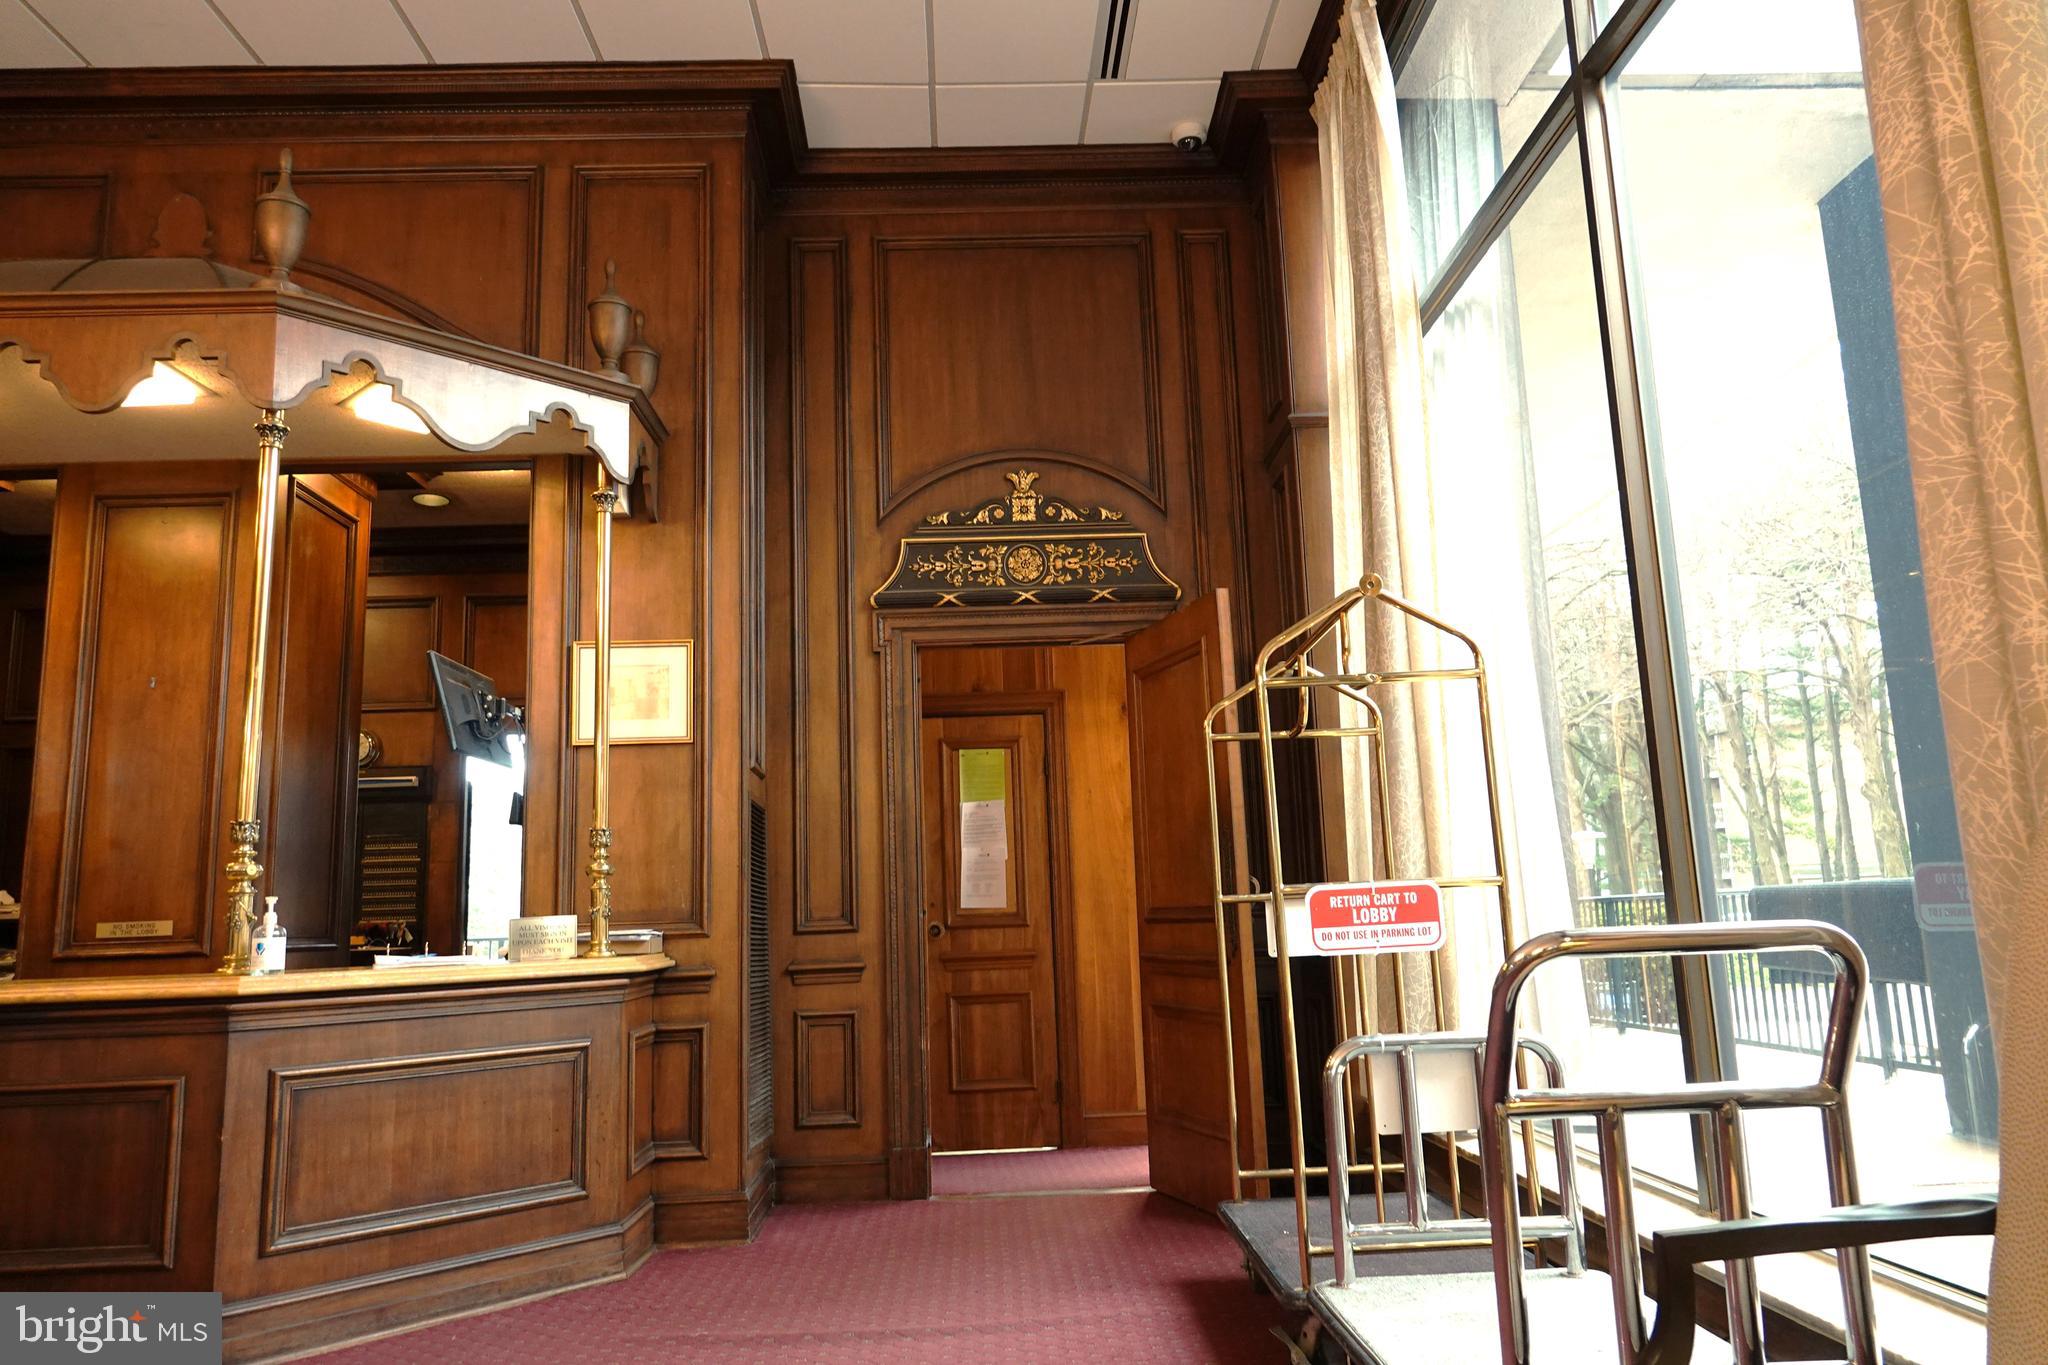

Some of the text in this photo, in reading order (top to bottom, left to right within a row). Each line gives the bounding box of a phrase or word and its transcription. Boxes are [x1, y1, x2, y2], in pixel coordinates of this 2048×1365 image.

[1329, 891, 1418, 909] RETURN CART TO
[1352, 906, 1397, 924] LOBBY
[519, 924, 533, 932] ALL
[1321, 926, 1432, 941] DO NOT USE IN PARKING LOT
